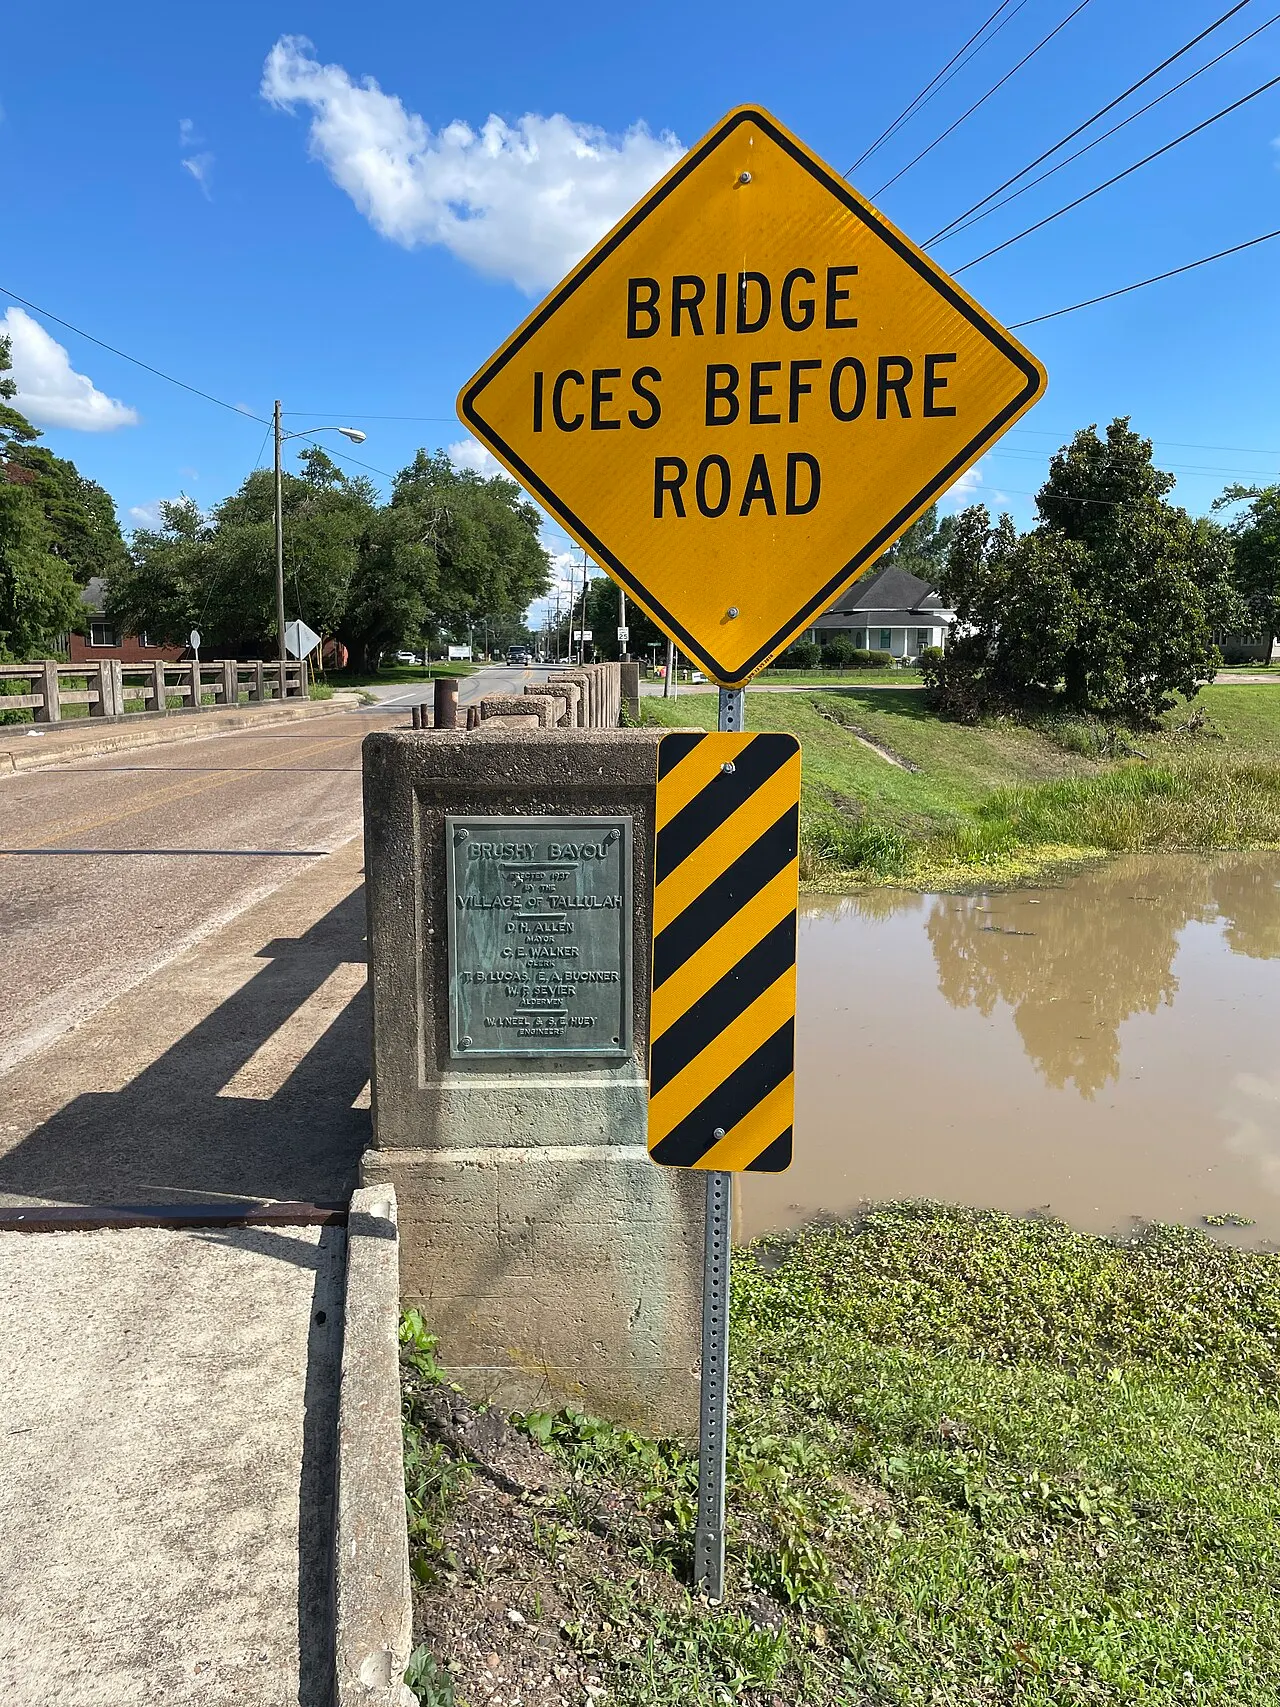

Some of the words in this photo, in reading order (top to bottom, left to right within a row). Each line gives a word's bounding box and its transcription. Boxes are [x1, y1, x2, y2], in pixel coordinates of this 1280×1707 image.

[626, 265, 859, 340] BRIDGE
[533, 366, 662, 433] ICES
[705, 352, 957, 427] BEFORE
[653, 452, 822, 519] ROAD
[469, 842, 539, 859] BRUSHY
[548, 842, 609, 859] BAYOU
[509, 871, 546, 879] ERECTED
[540, 883, 556, 891] THE
[456, 895, 522, 908] VILLAGE
[527, 896, 544, 907] OF
[548, 895, 623, 908] TALLULAH
[535, 922, 575, 932] ALLEN
[531, 946, 580, 956] WALKER
[527, 959, 556, 967] CLERK
[564, 971, 620, 982] BUCKNER
[534, 984, 577, 995] SEVIER
[505, 1016, 531, 1025] NEEL
[535, 1016, 543, 1025] &
[570, 1016, 598, 1025] HUEY
